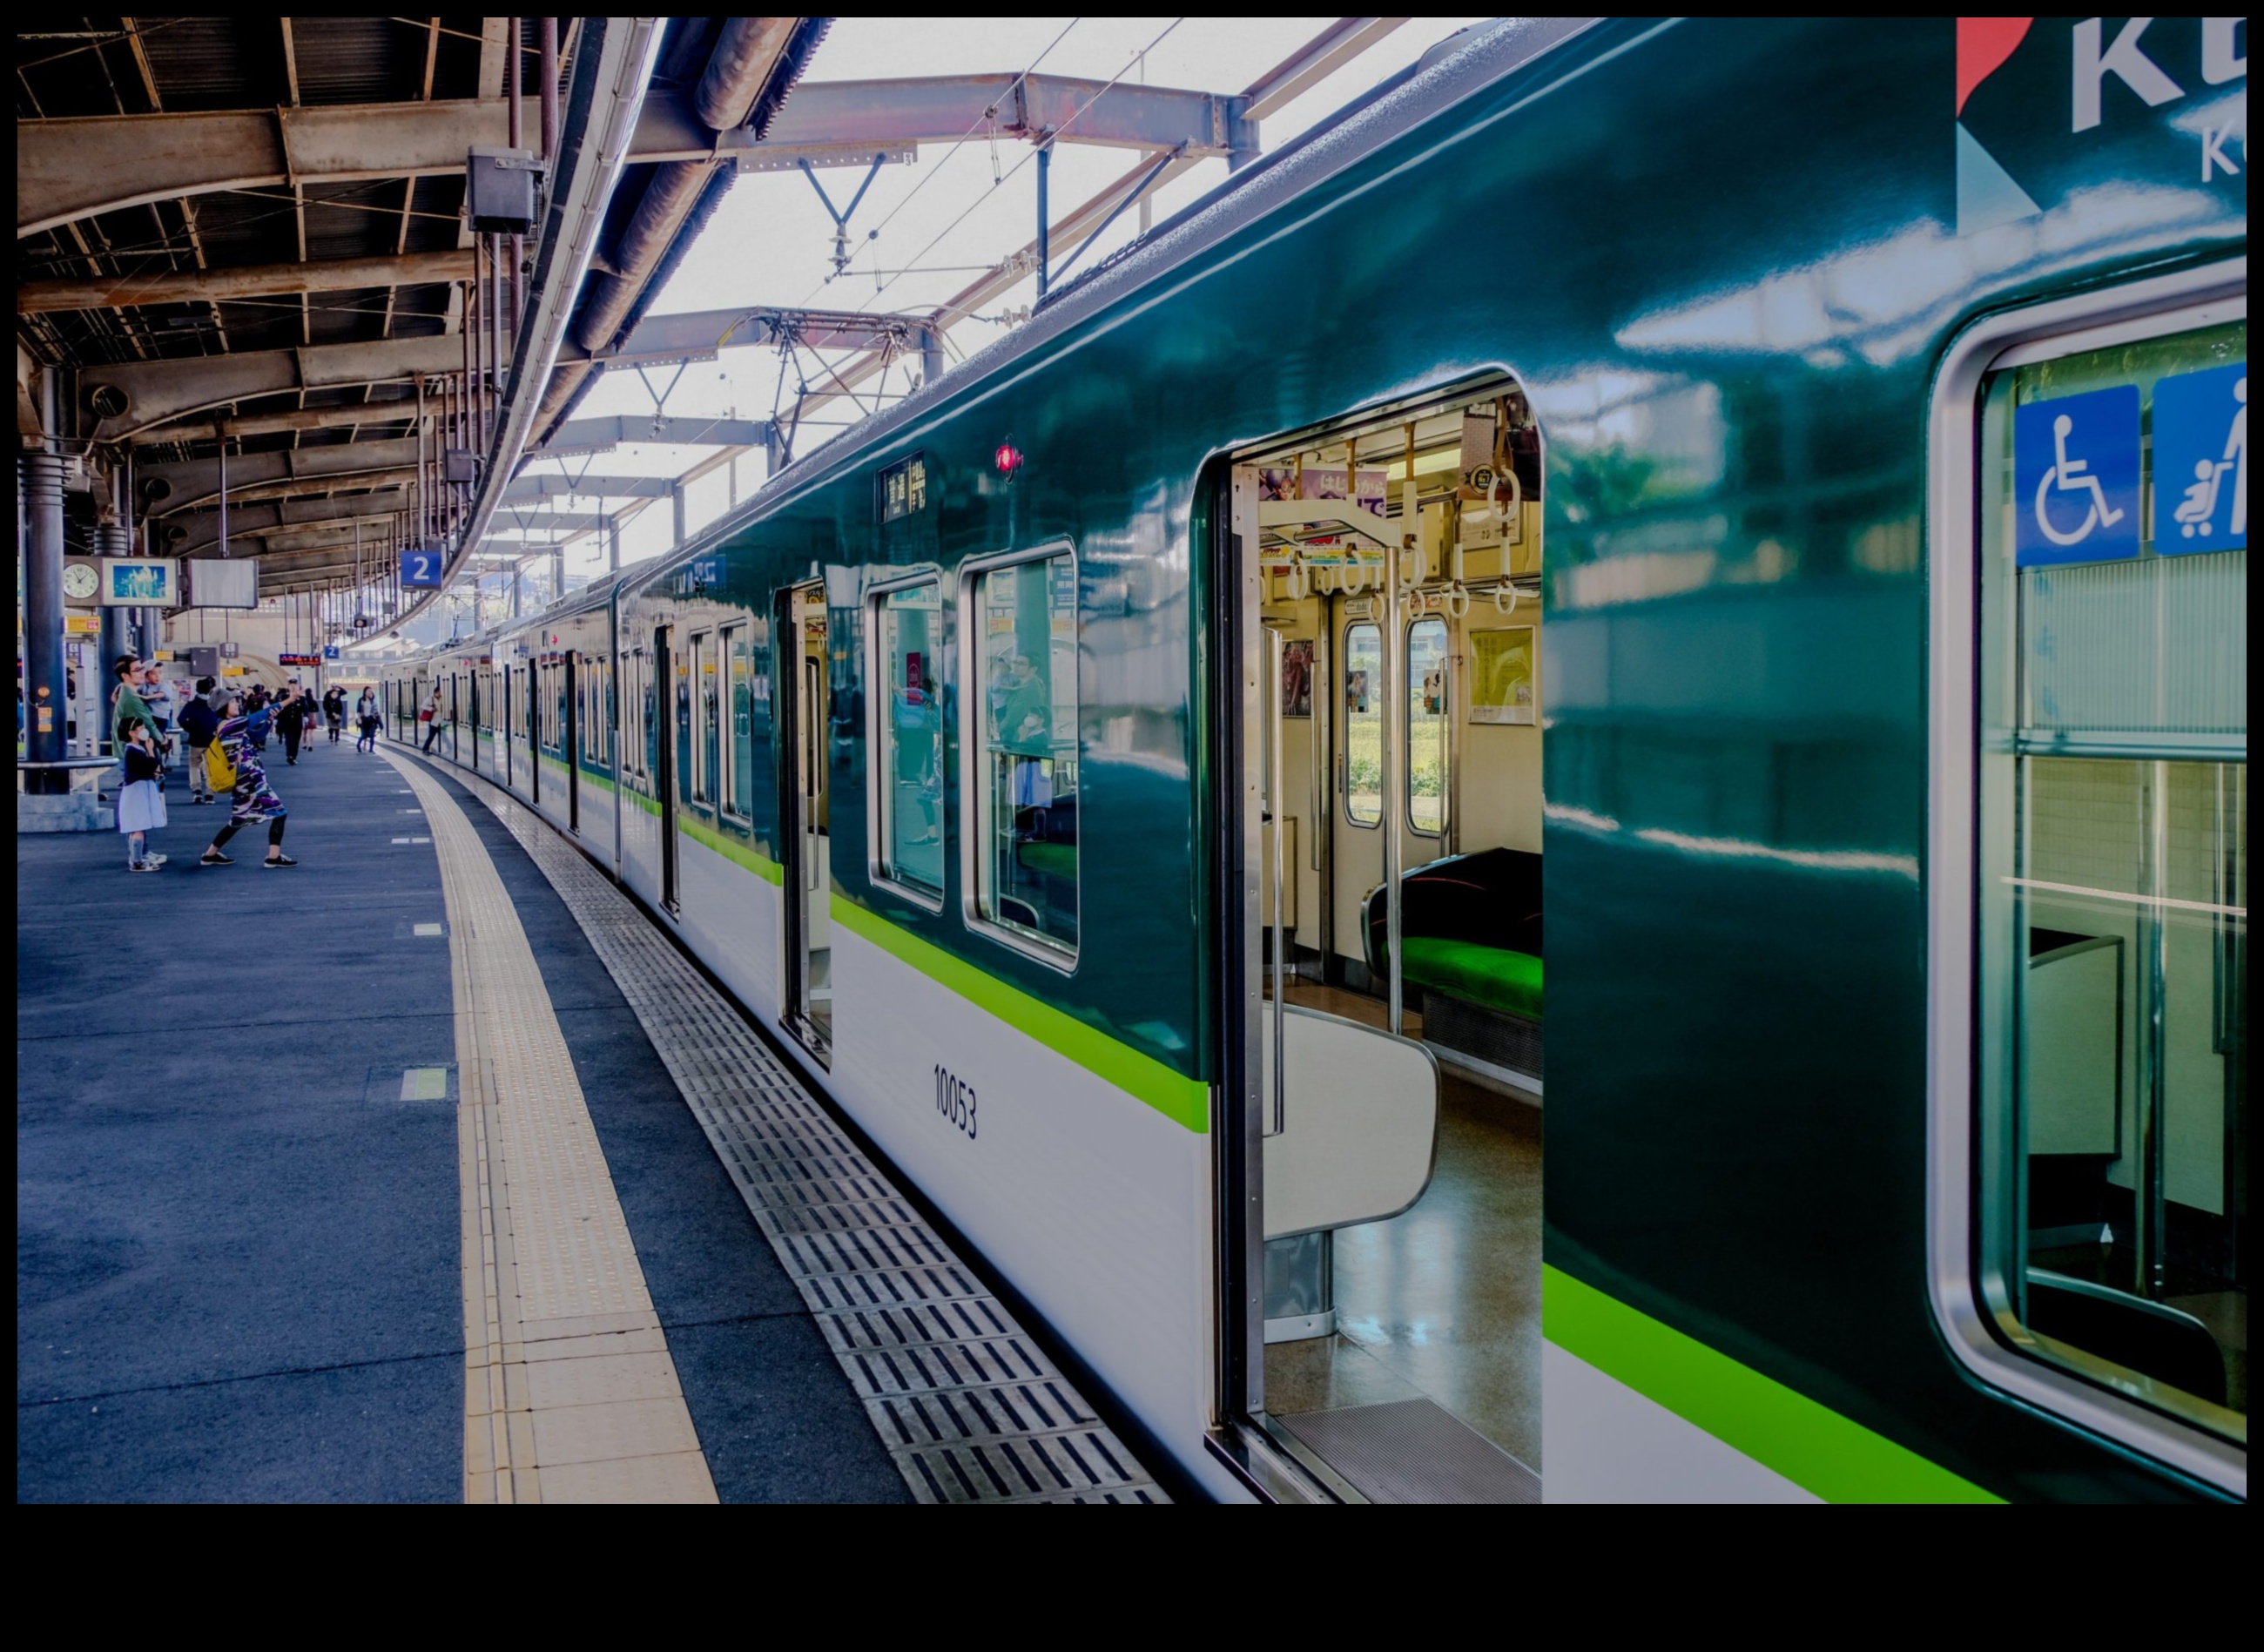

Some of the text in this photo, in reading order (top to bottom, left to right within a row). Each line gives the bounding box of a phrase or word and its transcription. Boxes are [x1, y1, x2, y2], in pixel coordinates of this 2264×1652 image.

[2201, 119, 2247, 183] K
[1320, 474, 1385, 496] はじから
[414, 556, 429, 580] 2
[328, 647, 336, 657] 2
[934, 1062, 977, 1140] 10053
